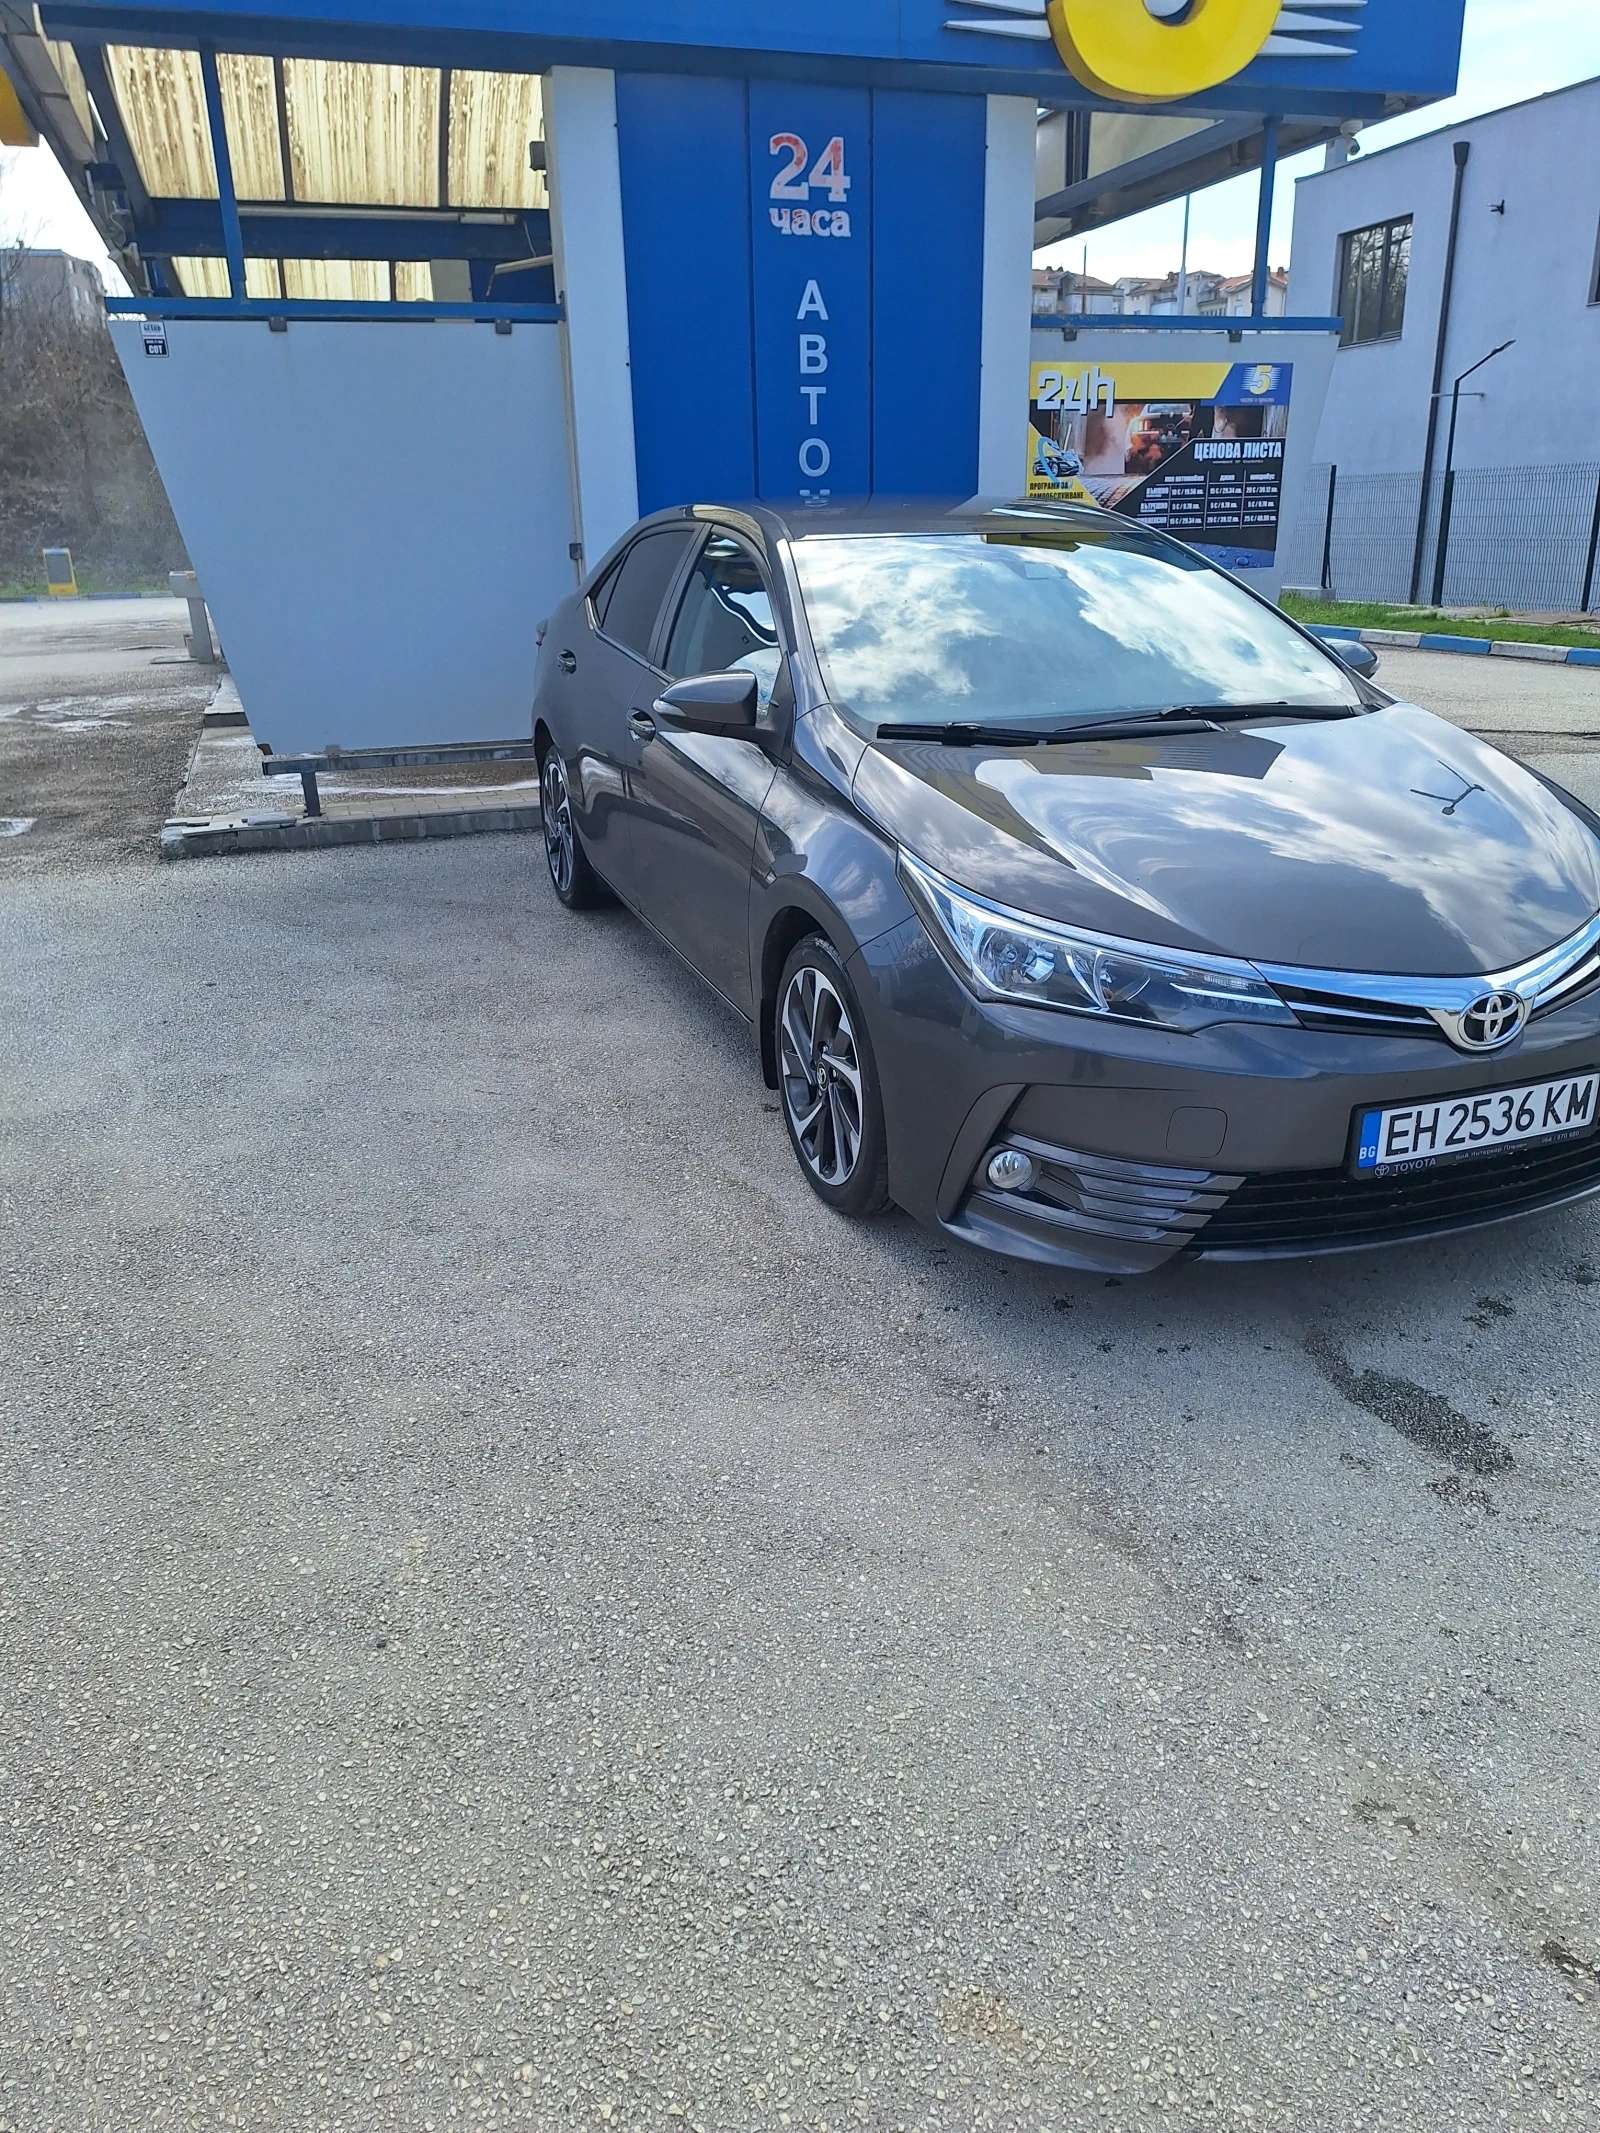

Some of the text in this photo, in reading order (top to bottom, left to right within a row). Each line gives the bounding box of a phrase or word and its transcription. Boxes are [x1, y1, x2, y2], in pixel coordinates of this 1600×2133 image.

[769, 132, 851, 202] 24
[769, 208, 851, 238] часа
[1036, 366, 1115, 418] 24h
[1250, 364, 1272, 394] 5
[1194, 442, 1282, 461] ЦЕНОВА ЛИСТА
[1445, 1090, 1535, 1146] 2536
[1359, 1146, 1376, 1160] BG
[1393, 1157, 1436, 1173] TOYOTA
